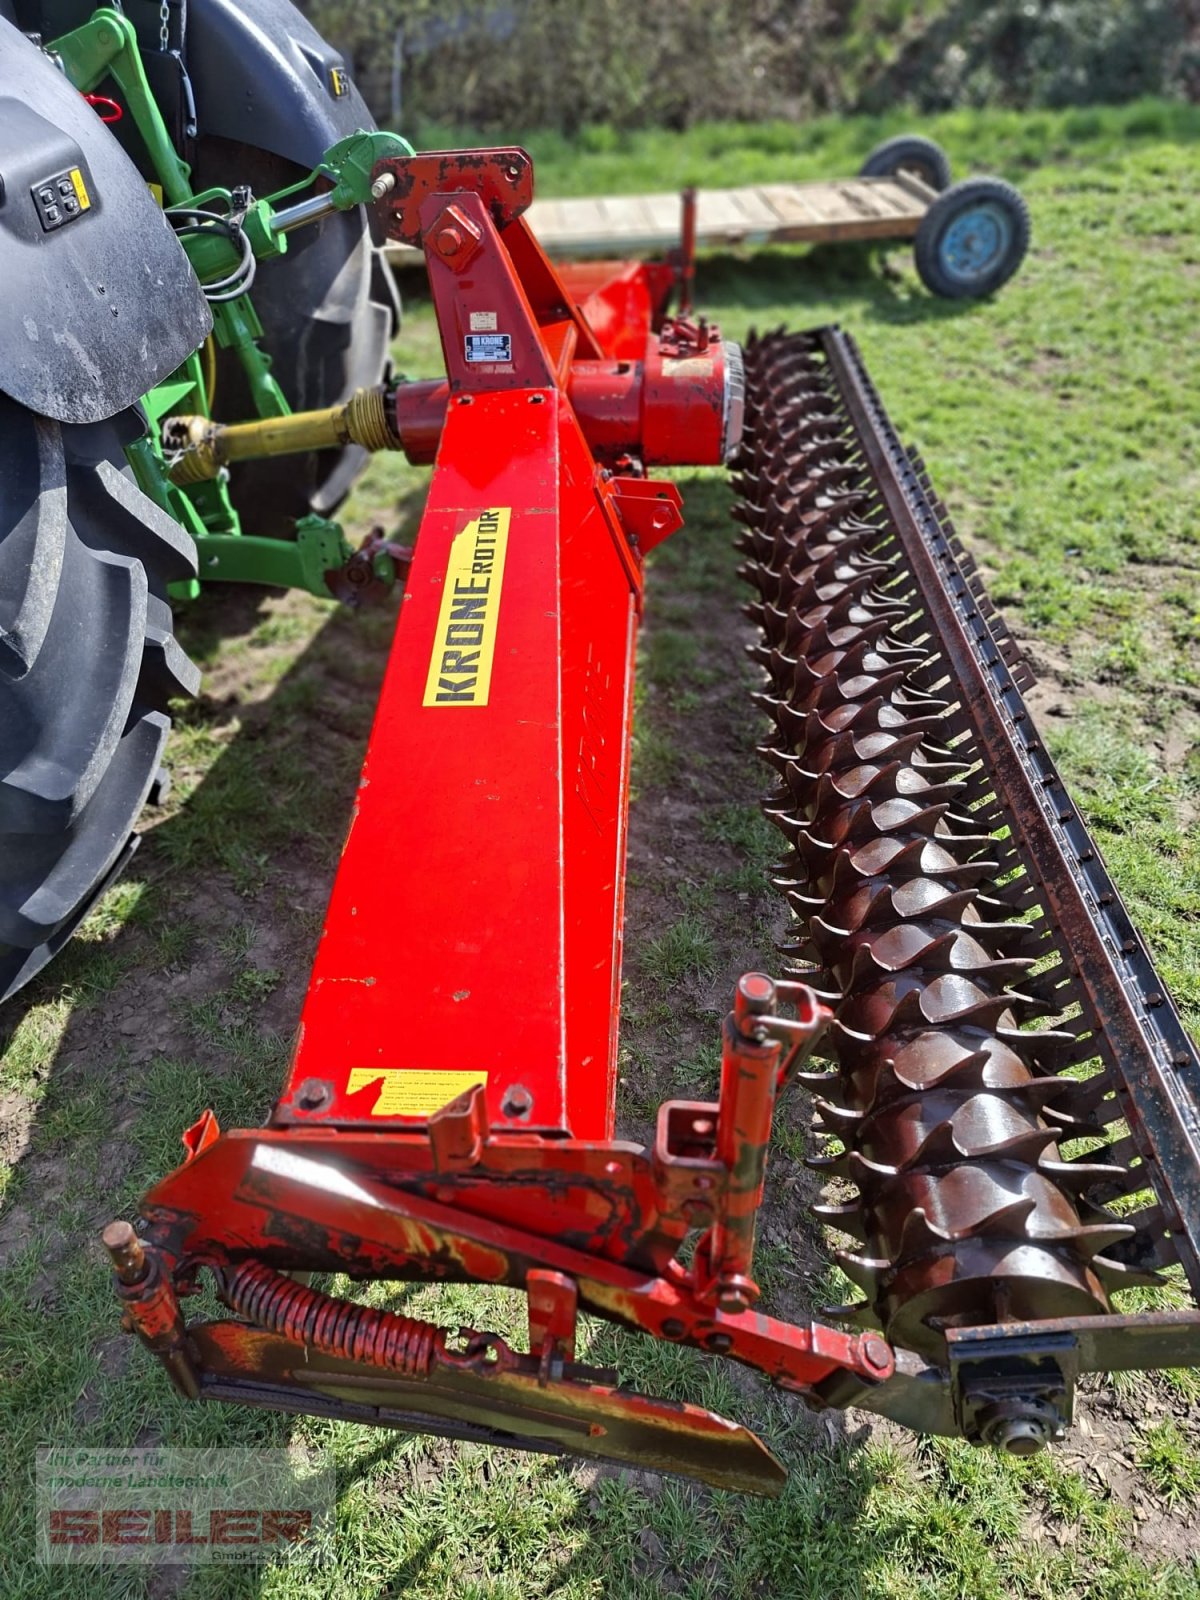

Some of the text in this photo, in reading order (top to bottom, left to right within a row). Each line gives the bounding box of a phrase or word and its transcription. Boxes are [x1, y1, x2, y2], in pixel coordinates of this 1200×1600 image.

[480, 336, 504, 346] KRONE
[435, 511, 500, 702] KRONE ROTOR
